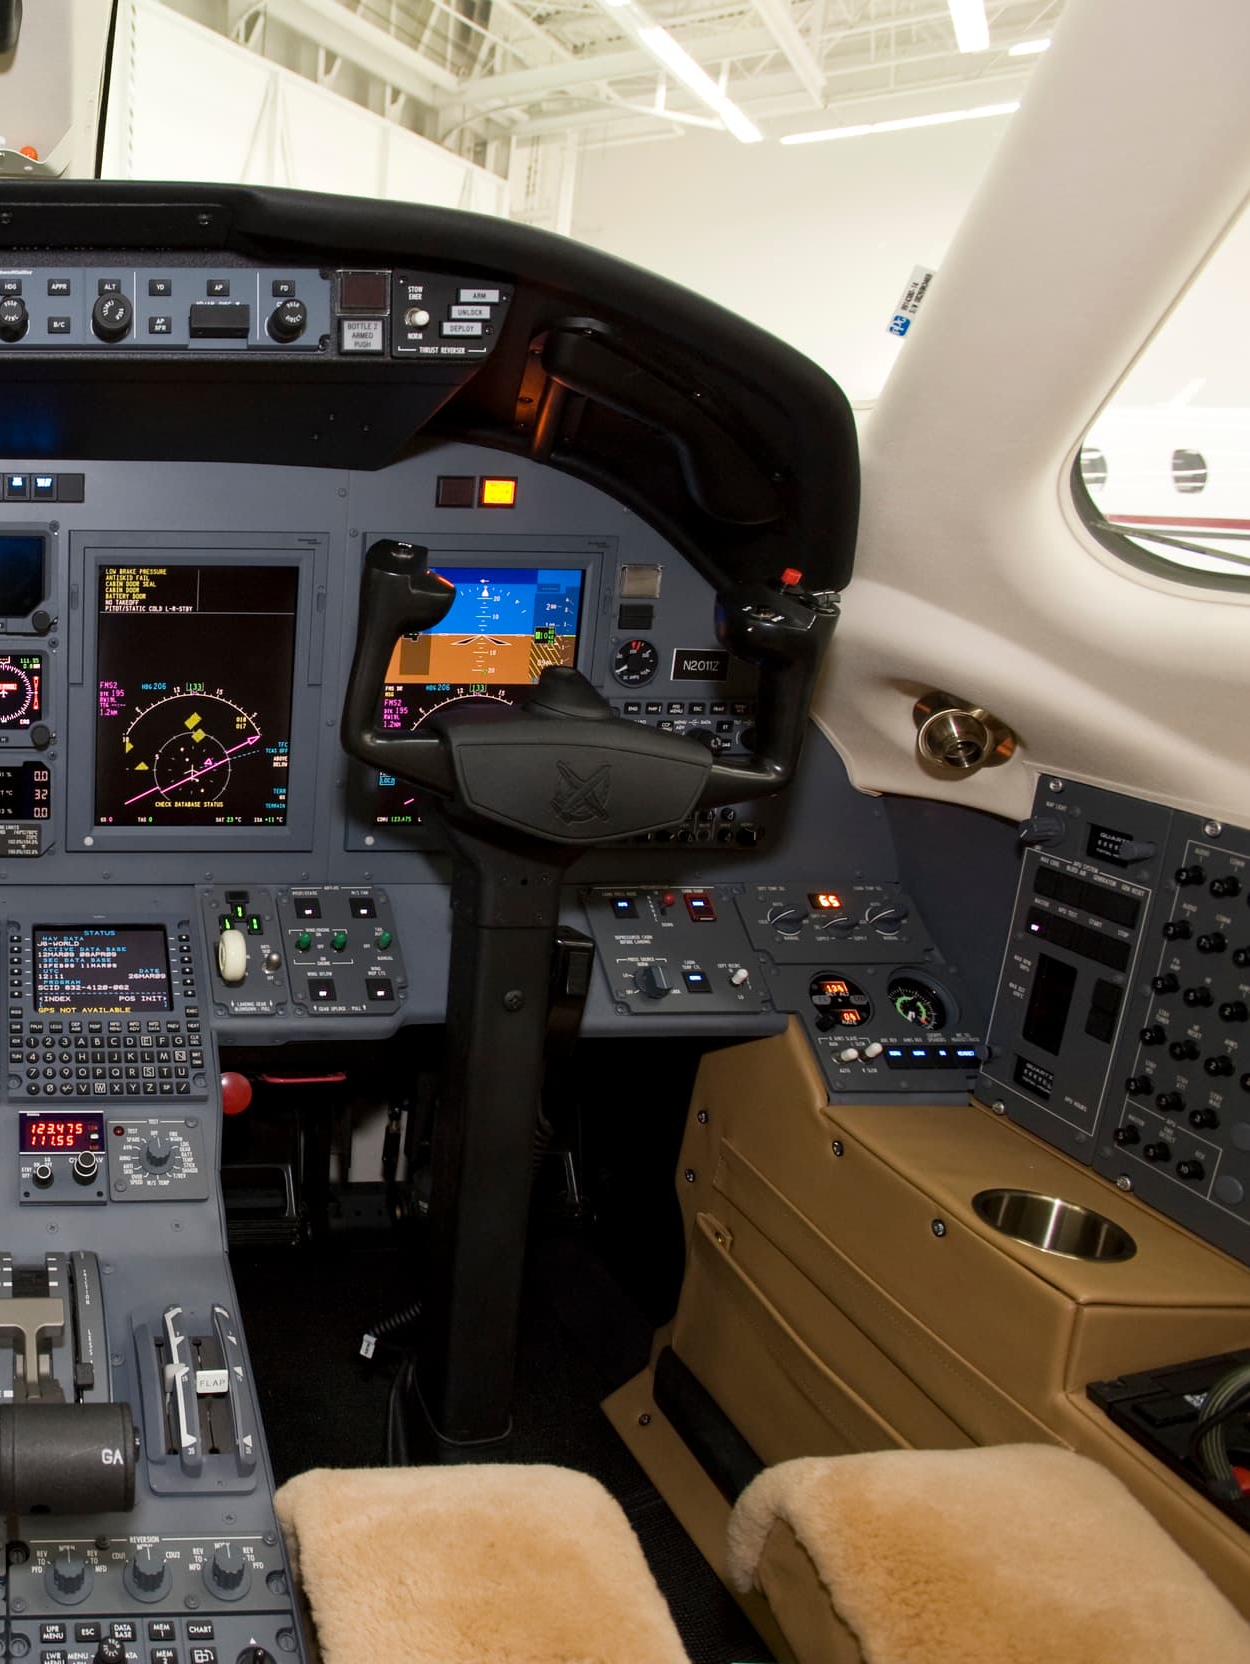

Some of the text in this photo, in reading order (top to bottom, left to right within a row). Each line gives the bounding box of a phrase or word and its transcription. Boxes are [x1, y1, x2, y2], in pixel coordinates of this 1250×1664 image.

[34, 771, 48, 782] 0.0
[35, 789, 48, 800] 32
[34, 808, 48, 818] 0.0
[819, 895, 840, 908] 65
[31, 1124, 82, 1134] 123.475
[32, 1136, 73, 1145] 111.55
[200, 1379, 225, 1387] FLAP
[102, 1450, 123, 1464] GA
[81, 1628, 94, 1636] ESC
[154, 1623, 170, 1631] MEM
